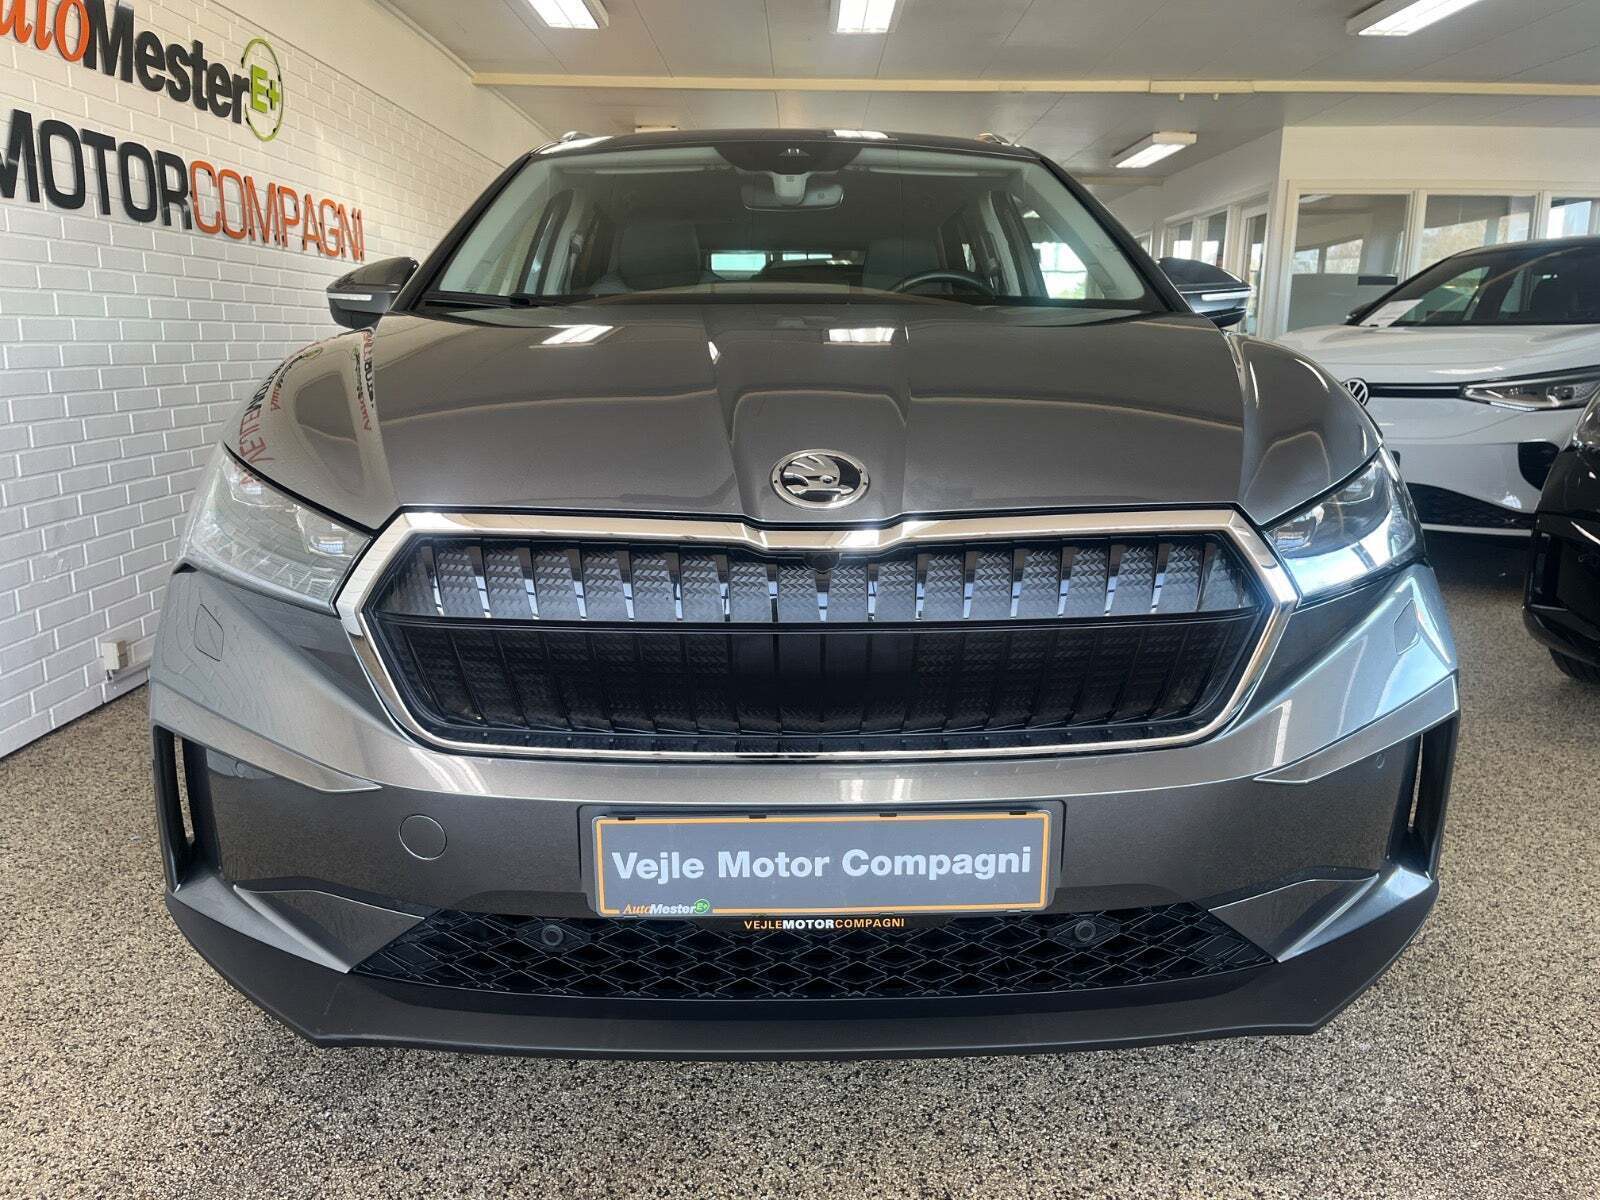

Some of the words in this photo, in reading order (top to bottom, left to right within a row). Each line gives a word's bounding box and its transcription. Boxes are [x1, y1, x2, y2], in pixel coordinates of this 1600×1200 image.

[612, 850, 705, 885] Vejle
[717, 849, 830, 879] Motor
[842, 846, 1032, 881] Compagni
